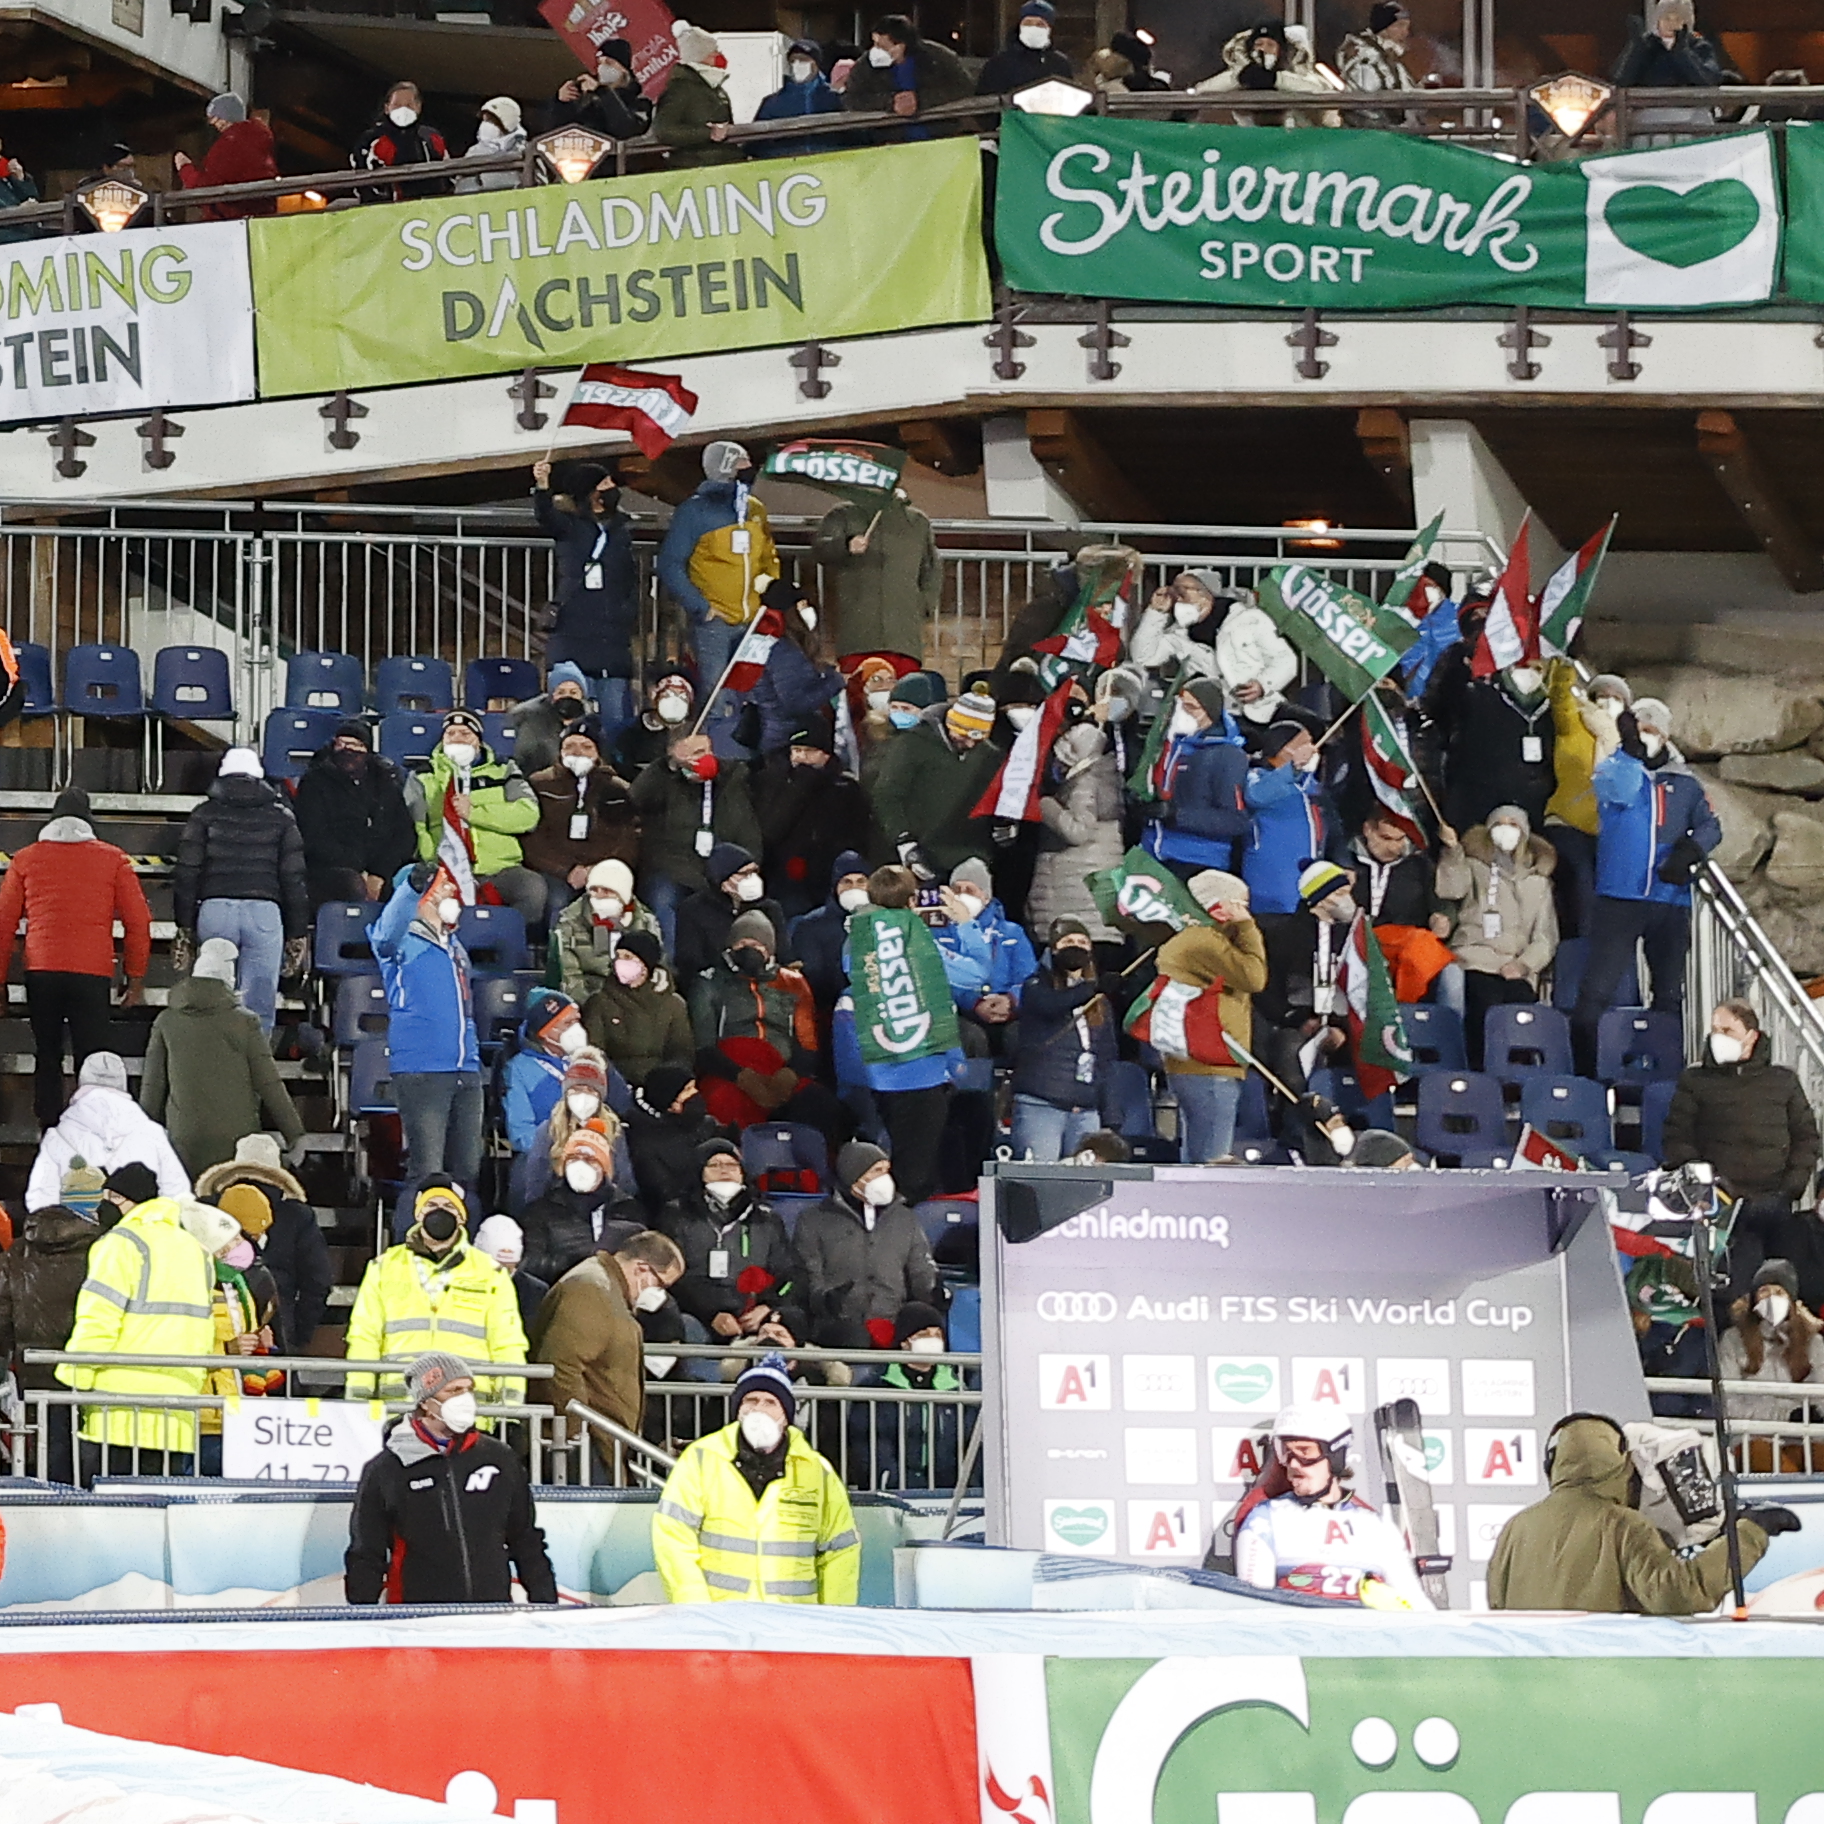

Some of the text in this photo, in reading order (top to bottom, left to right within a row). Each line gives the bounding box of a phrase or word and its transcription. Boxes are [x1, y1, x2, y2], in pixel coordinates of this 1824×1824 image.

[400, 175, 827, 273] SCHLADMING
[1038, 143, 1540, 273] Steiermark
[1198, 240, 1374, 283] SPORT
[443, 251, 804, 347] DACHSTEIN
[776, 448, 896, 488] Gösser
[1279, 566, 1388, 666] Gösser
[873, 920, 931, 1054] Gösser
[1126, 1296, 1533, 1332] Audi FIS Ski World Cup
[1056, 1360, 1096, 1405] A1
[1311, 1363, 1350, 1405] A1
[254, 1416, 333, 1447] Sitze
[1482, 1434, 1522, 1479] A1
[1147, 1505, 1188, 1550] A1
